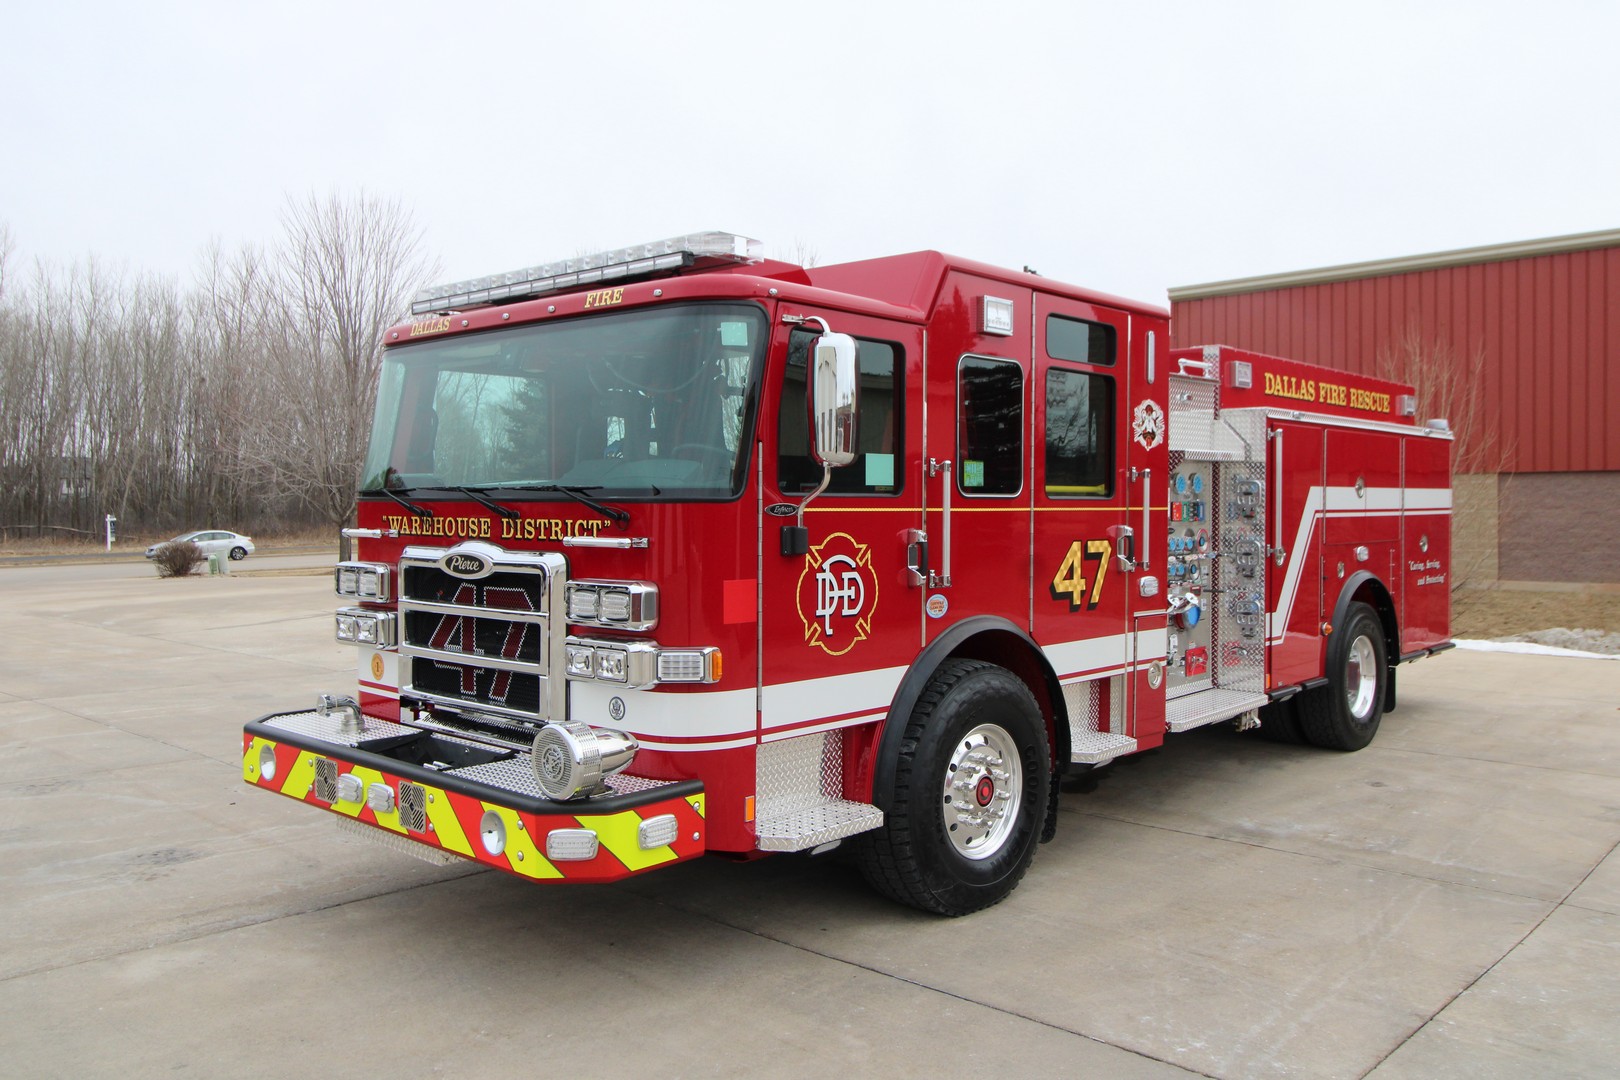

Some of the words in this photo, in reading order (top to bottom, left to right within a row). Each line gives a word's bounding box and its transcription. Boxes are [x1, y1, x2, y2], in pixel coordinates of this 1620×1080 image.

[584, 287, 624, 308] FIRE
[410, 317, 451, 337] DALLAS
[1264, 372, 1315, 402] DALLAS
[1319, 382, 1347, 406] FIRE
[1349, 388, 1390, 414] RESCUE
[451, 555, 480, 571] Pierce
[1052, 540, 1112, 606] 47
